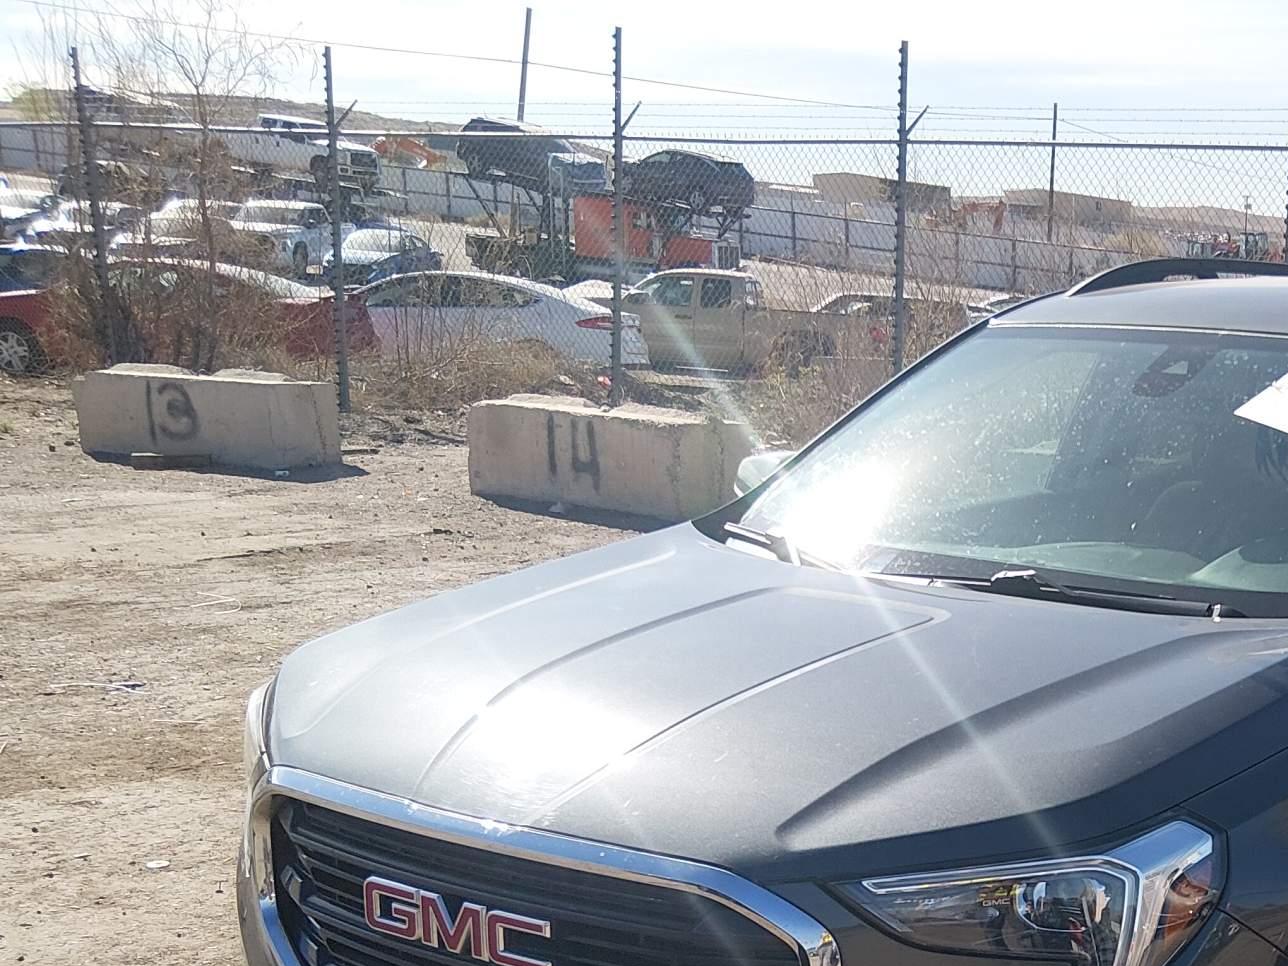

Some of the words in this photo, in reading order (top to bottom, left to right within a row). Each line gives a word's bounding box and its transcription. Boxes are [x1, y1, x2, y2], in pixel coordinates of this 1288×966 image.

[145, 380, 200, 446] 13
[547, 413, 601, 496] 14
[982, 897, 1011, 907] GMC
